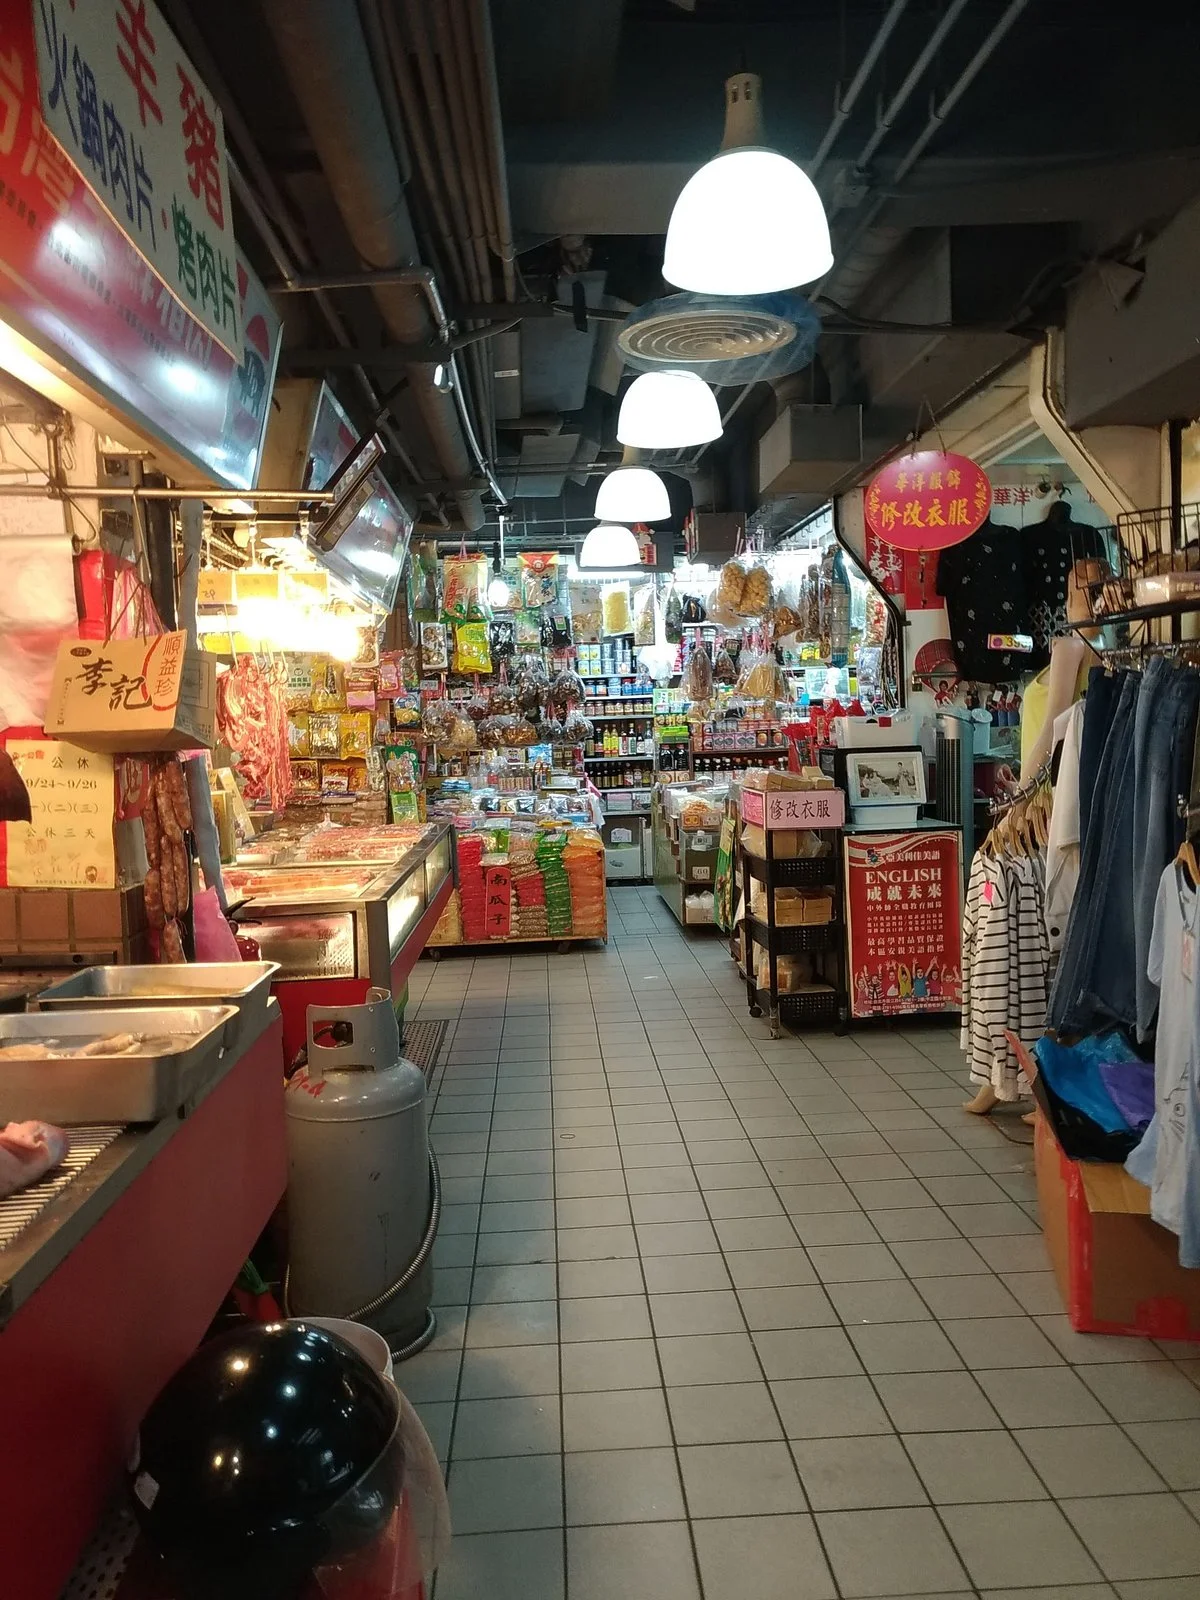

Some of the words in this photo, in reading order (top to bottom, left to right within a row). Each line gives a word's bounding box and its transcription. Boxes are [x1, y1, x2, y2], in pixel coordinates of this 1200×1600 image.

[880, 498, 972, 532] 修改衣服
[154, 635, 183, 697] 順益珍
[75, 657, 153, 711] 李記
[51, 755, 90, 771] 公休
[770, 798, 831, 820] 修改衣服
[25, 827, 97, 840] 公休三天
[865, 867, 943, 885] ENGLISH
[488, 873, 508, 925] 南瓜子
[867, 882, 943, 902] 成就未來
